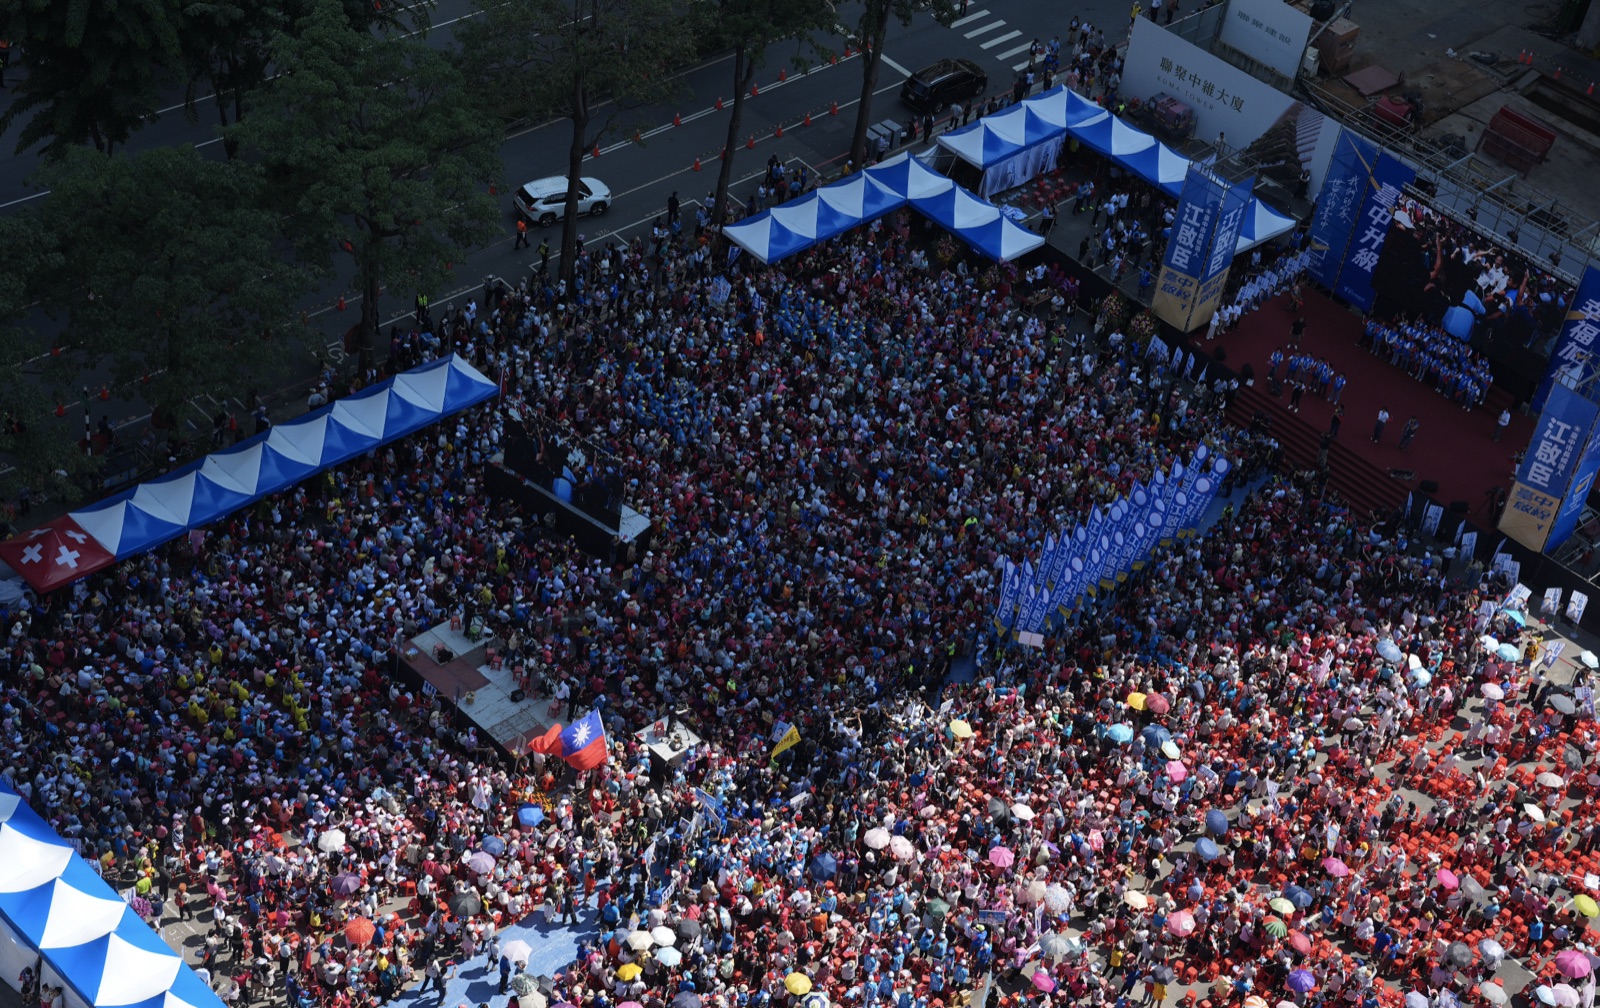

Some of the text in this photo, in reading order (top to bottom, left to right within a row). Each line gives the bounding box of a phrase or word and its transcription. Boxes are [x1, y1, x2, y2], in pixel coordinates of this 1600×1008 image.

[1157, 75, 1214, 111] KUMA TOWER
[1160, 56, 1244, 113] 聯聚中維大廈
[1171, 201, 1204, 270] 江啟臣
[1351, 181, 1402, 273] 臺中升級
[1550, 298, 1600, 378] 幸福加
[1527, 416, 1572, 488] 江啟臣
